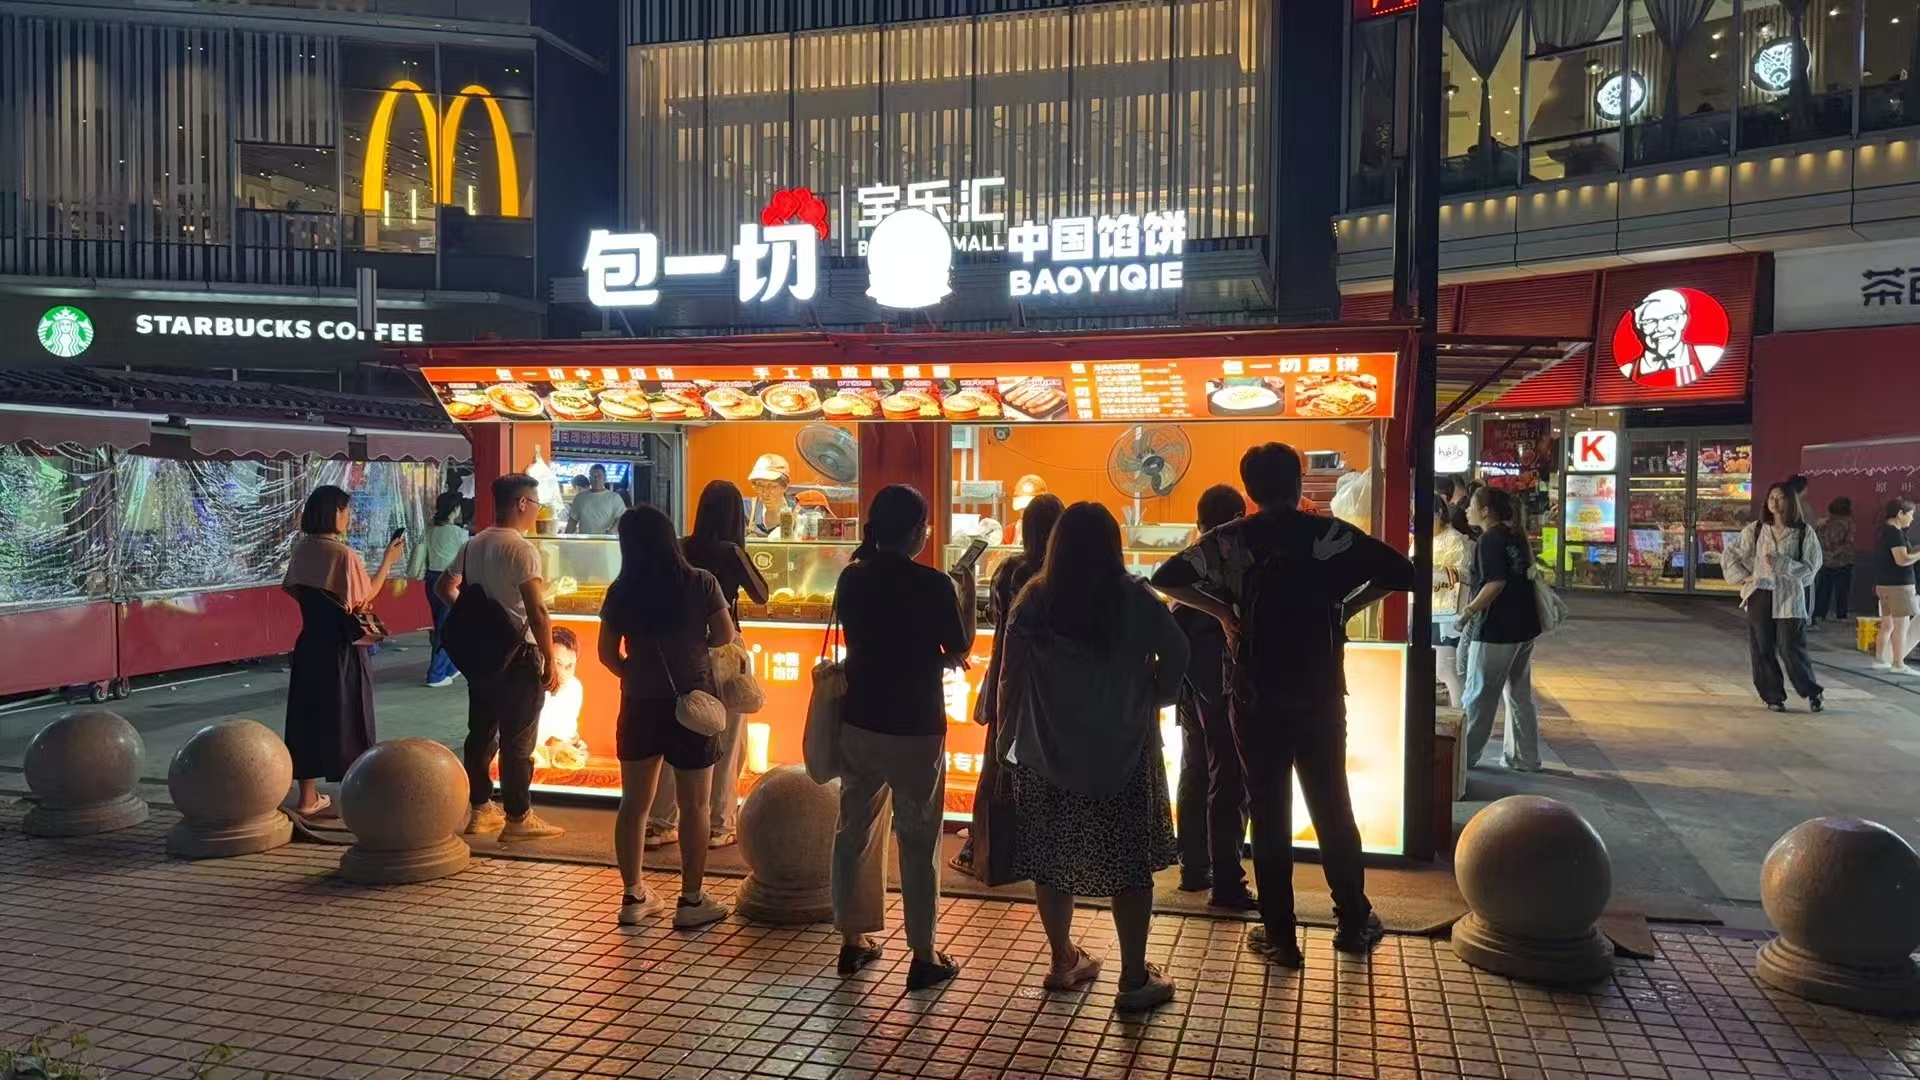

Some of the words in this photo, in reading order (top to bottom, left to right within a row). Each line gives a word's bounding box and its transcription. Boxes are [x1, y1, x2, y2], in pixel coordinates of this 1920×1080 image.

[858, 177, 1006, 227] 宝乐汇
[952, 234, 1005, 252] MALL
[1009, 210, 1187, 263] 中国馅饼
[583, 223, 818, 307] 包一切
[1010, 261, 1183, 296] BAOYIQIE
[1861, 266, 1920, 306] 茶
[136, 314, 312, 339] STARBUCKS
[317, 320, 423, 342] COFEE
[1581, 435, 1605, 462] K
